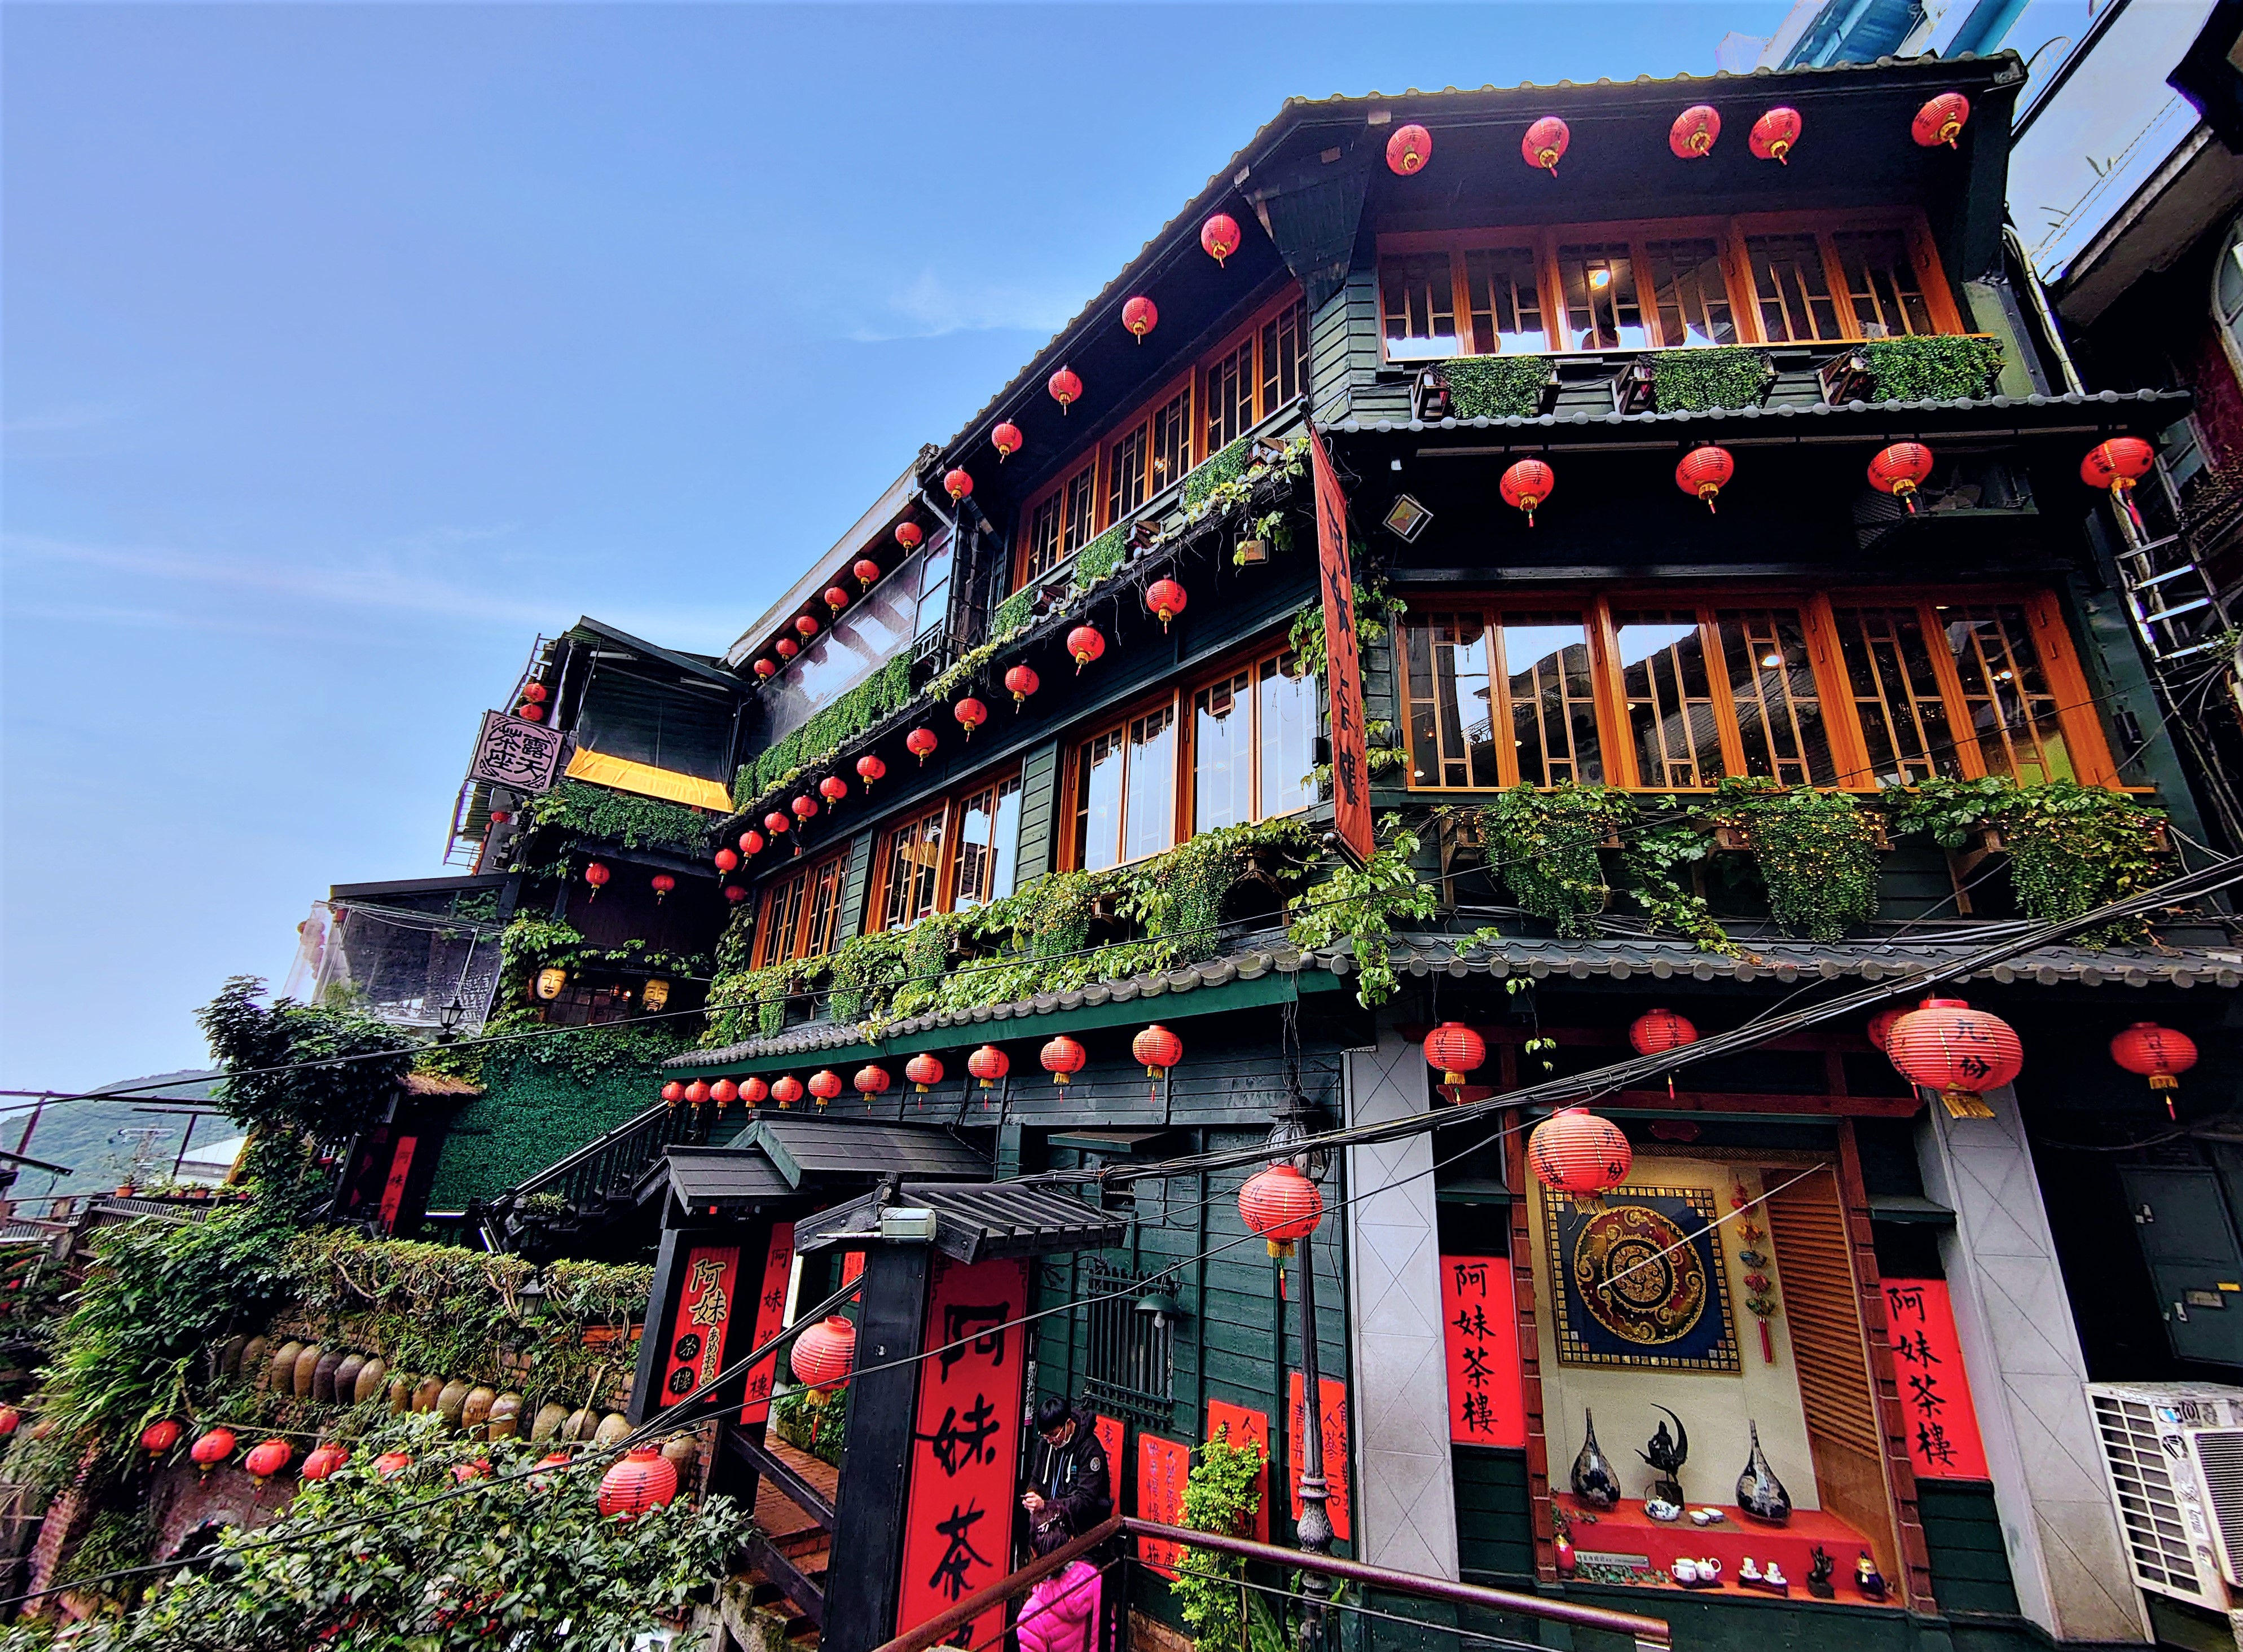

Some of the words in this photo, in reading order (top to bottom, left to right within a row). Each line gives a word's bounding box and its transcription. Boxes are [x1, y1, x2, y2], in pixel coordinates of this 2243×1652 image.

[489, 726, 522, 773] 茶座
[514, 734, 551, 778] 露天
[1955, 1019, 1991, 1079] 九份
[689, 1259, 727, 1325] 阿妹
[1452, 1263, 1499, 1435] 阿妹茶樓
[1886, 1286, 1959, 1468] 阿妹茶樓
[915, 1301, 1010, 1650] 阿妹茶
